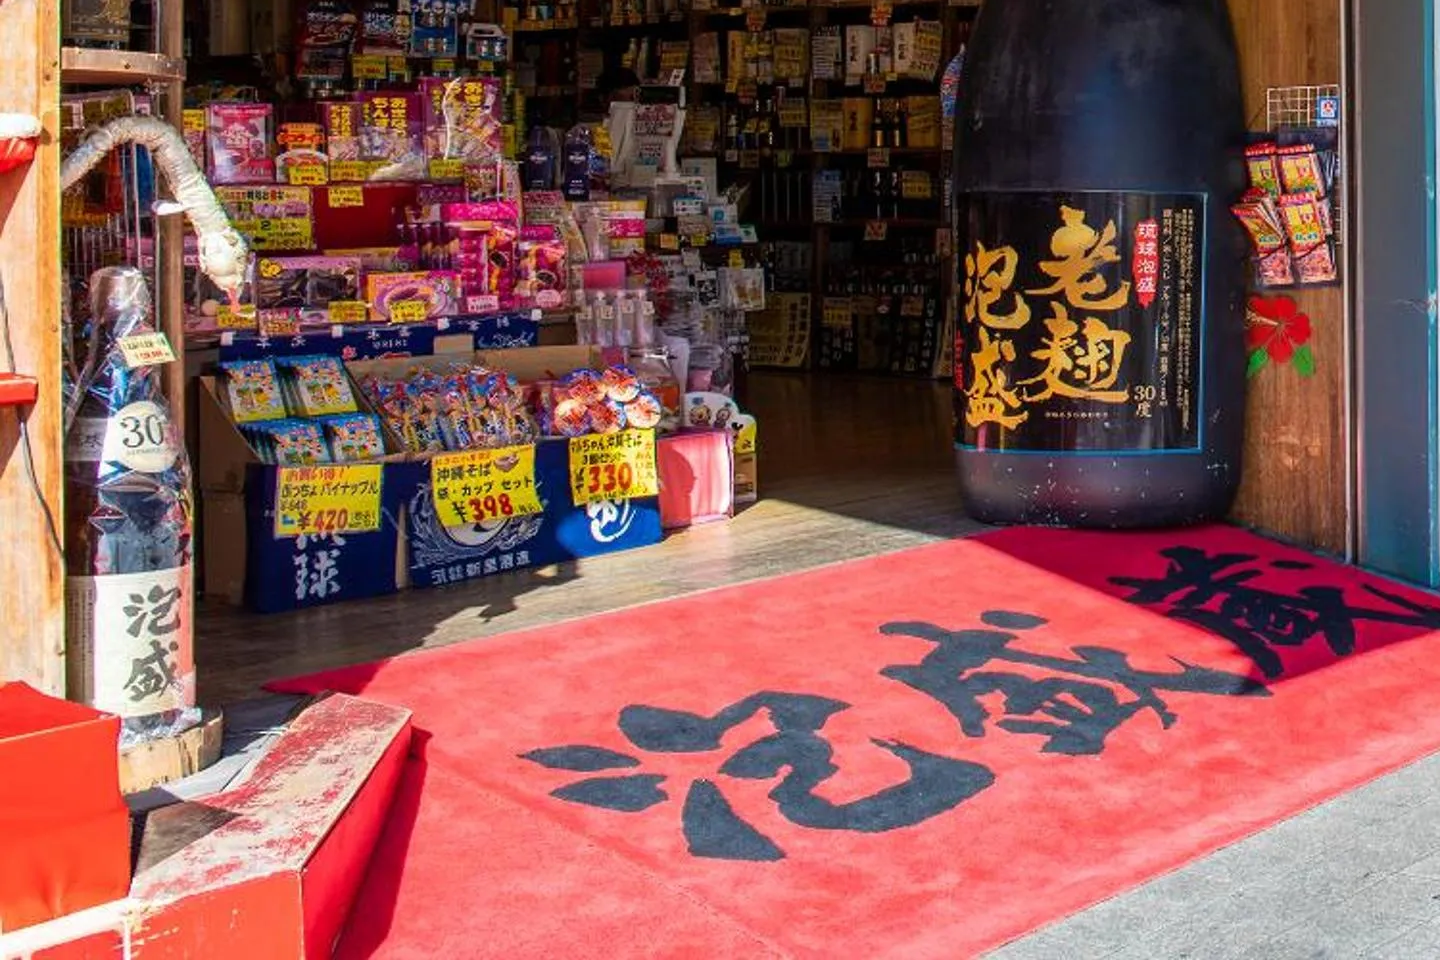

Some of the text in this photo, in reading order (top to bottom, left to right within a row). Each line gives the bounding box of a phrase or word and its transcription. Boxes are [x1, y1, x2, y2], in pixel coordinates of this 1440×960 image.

[1137, 223, 1158, 293] 琉球泡盛
[964, 240, 1031, 430] 泡盛
[120, 414, 165, 448] 30
[297, 507, 349, 531] ¥420
[452, 493, 514, 524] ¥398
[122, 584, 182, 703] 泡盛
